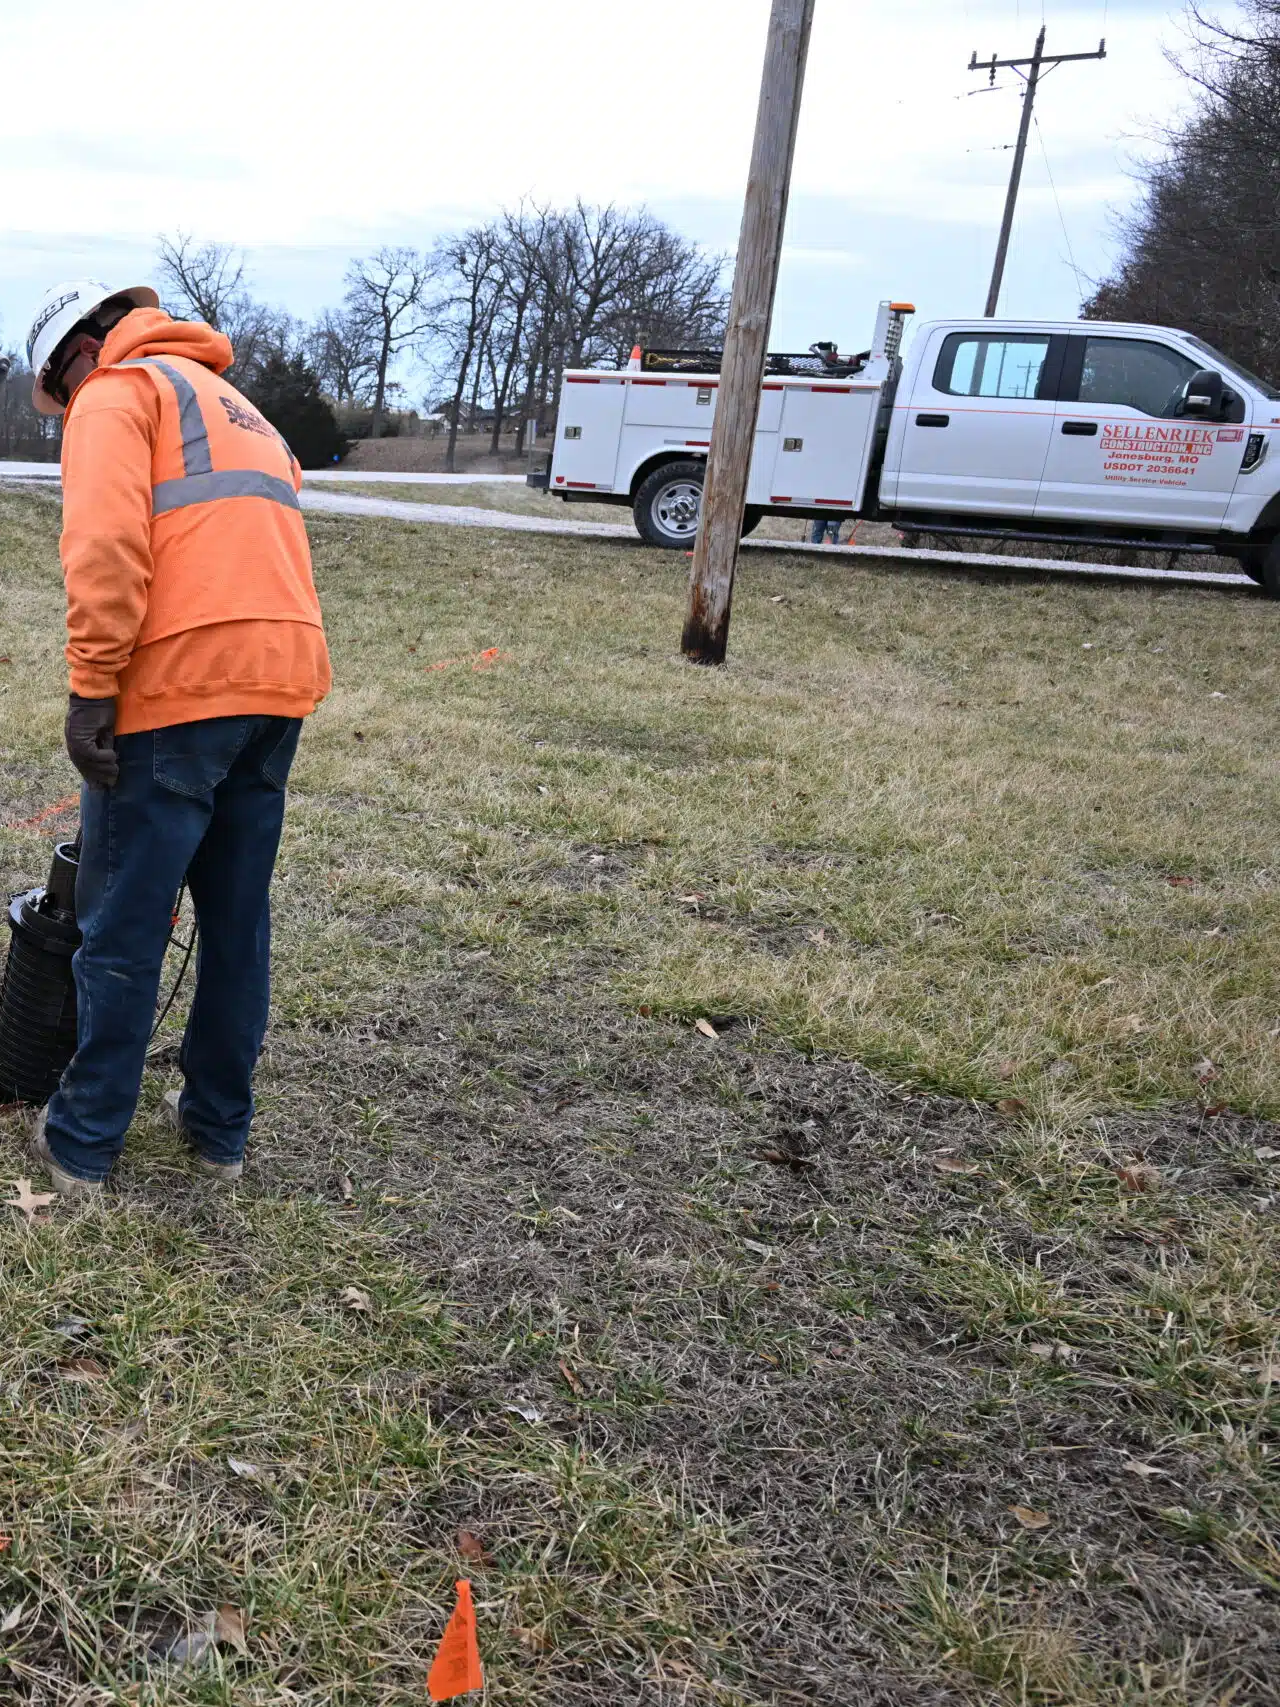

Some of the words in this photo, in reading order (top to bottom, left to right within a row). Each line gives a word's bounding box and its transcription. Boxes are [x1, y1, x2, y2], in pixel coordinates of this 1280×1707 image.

[1102, 423, 1216, 443] SELLENRIEK
[1178, 455, 1199, 464] MO
[1103, 462, 1144, 471] USDOT
[1146, 464, 1196, 475] 2036641
[1128, 475, 1157, 484] Service
[1159, 478, 1187, 487] Vehicle
